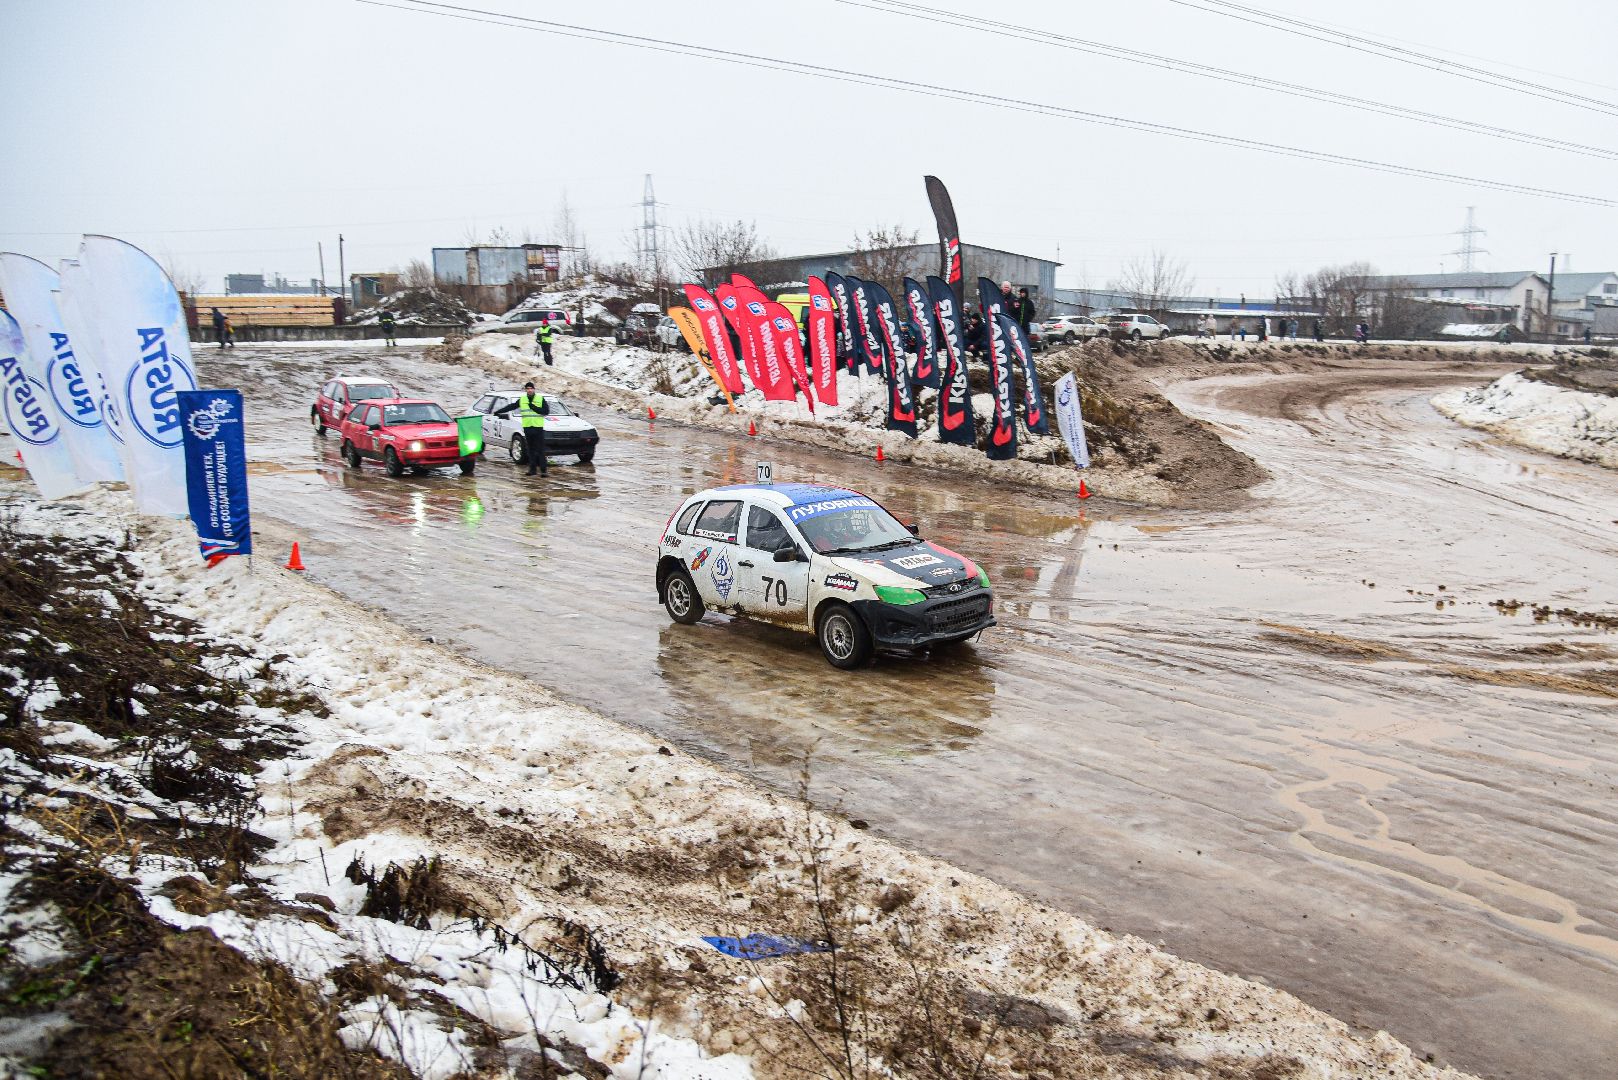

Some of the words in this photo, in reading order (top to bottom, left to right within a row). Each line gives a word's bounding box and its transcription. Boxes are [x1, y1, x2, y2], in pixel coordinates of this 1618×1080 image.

[758, 465, 771, 479] 70
[827, 577, 856, 588] KRAMAR
[761, 575, 788, 607] 70
